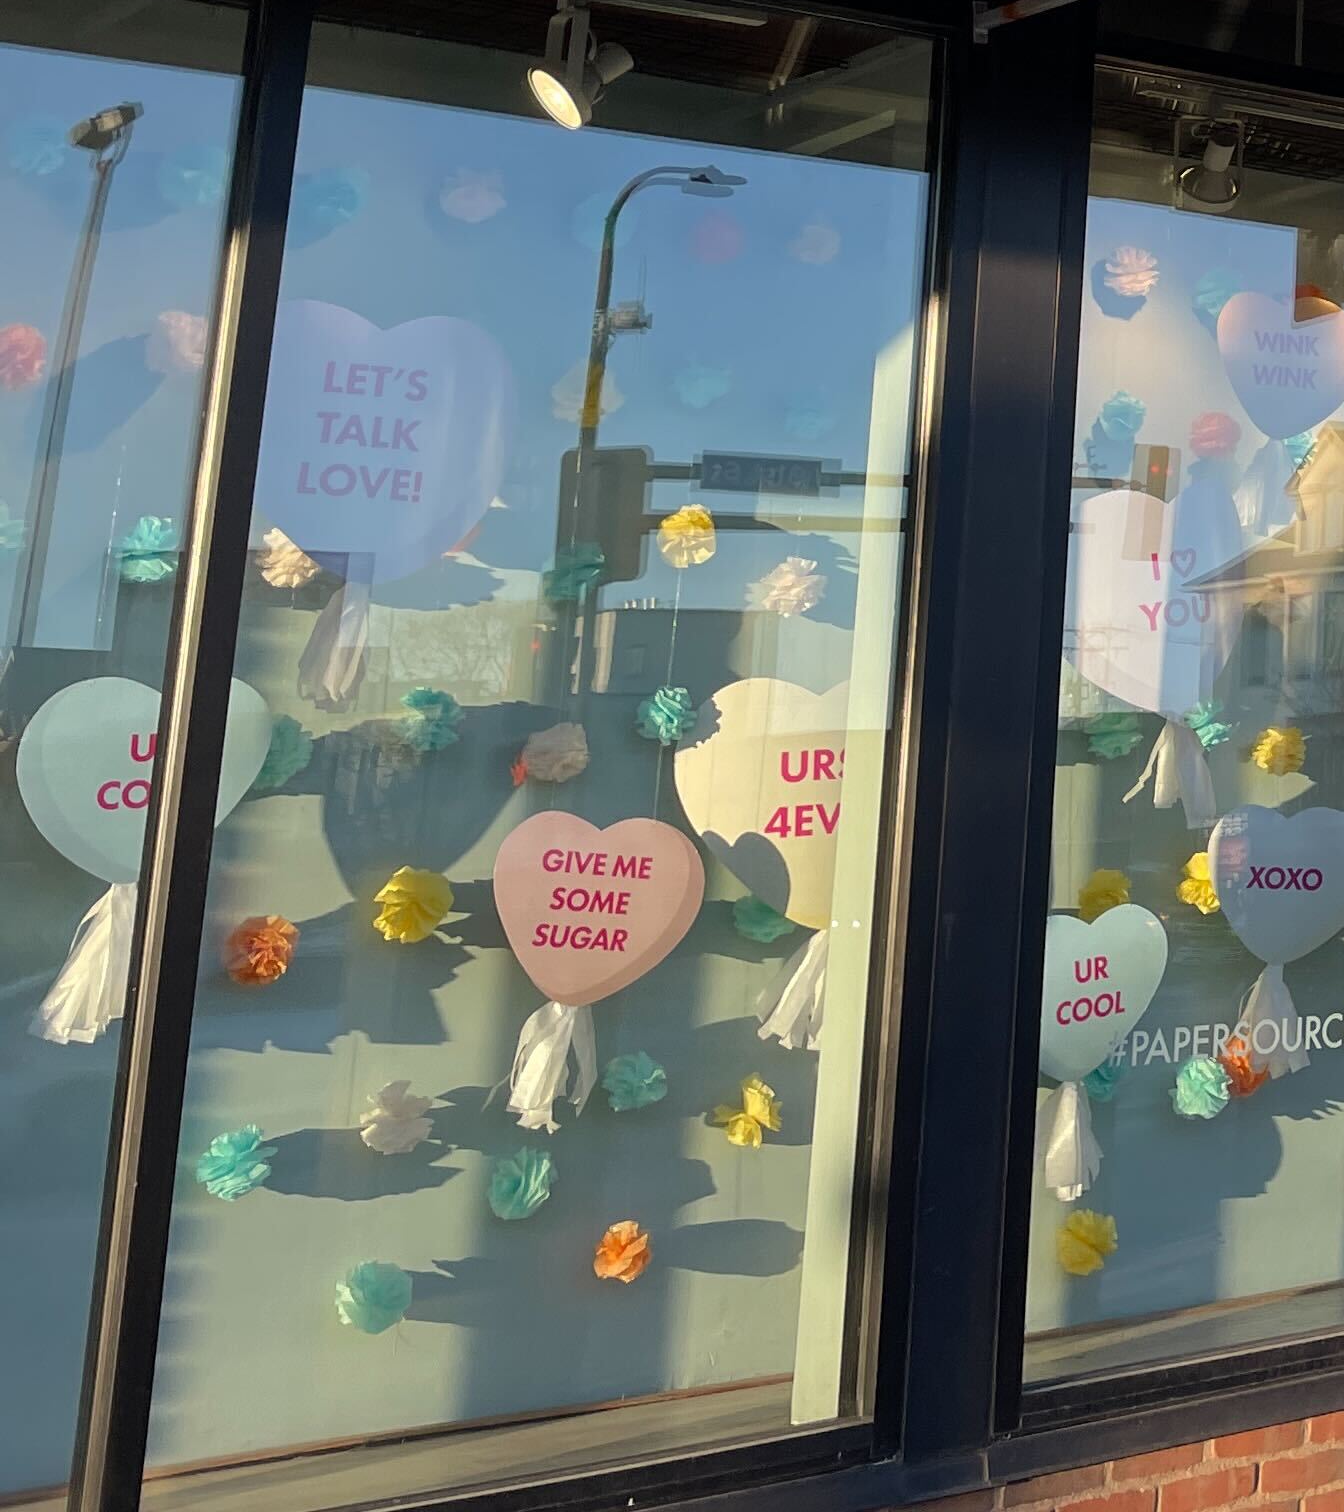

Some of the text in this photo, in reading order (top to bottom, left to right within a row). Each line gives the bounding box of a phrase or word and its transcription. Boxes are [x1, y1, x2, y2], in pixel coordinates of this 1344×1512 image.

[1254, 331, 1320, 358] WINK
[1252, 363, 1318, 390] WINK
[316, 411, 422, 453] TALK
[296, 461, 424, 503] LOVE!
[1151, 552, 1161, 581] I
[1138, 595, 1212, 632] YOU
[130, 733, 158, 762] U
[781, 748, 845, 783] UR
[96, 779, 154, 810] CO
[764, 802, 841, 838] 4EV
[542, 849, 653, 879] GIVE ME
[1246, 865, 1323, 892] XOXO
[549, 887, 631, 915] SOME
[531, 923, 628, 952] SUGAR
[1074, 955, 1109, 983] UR
[1056, 991, 1126, 1026] COOL
